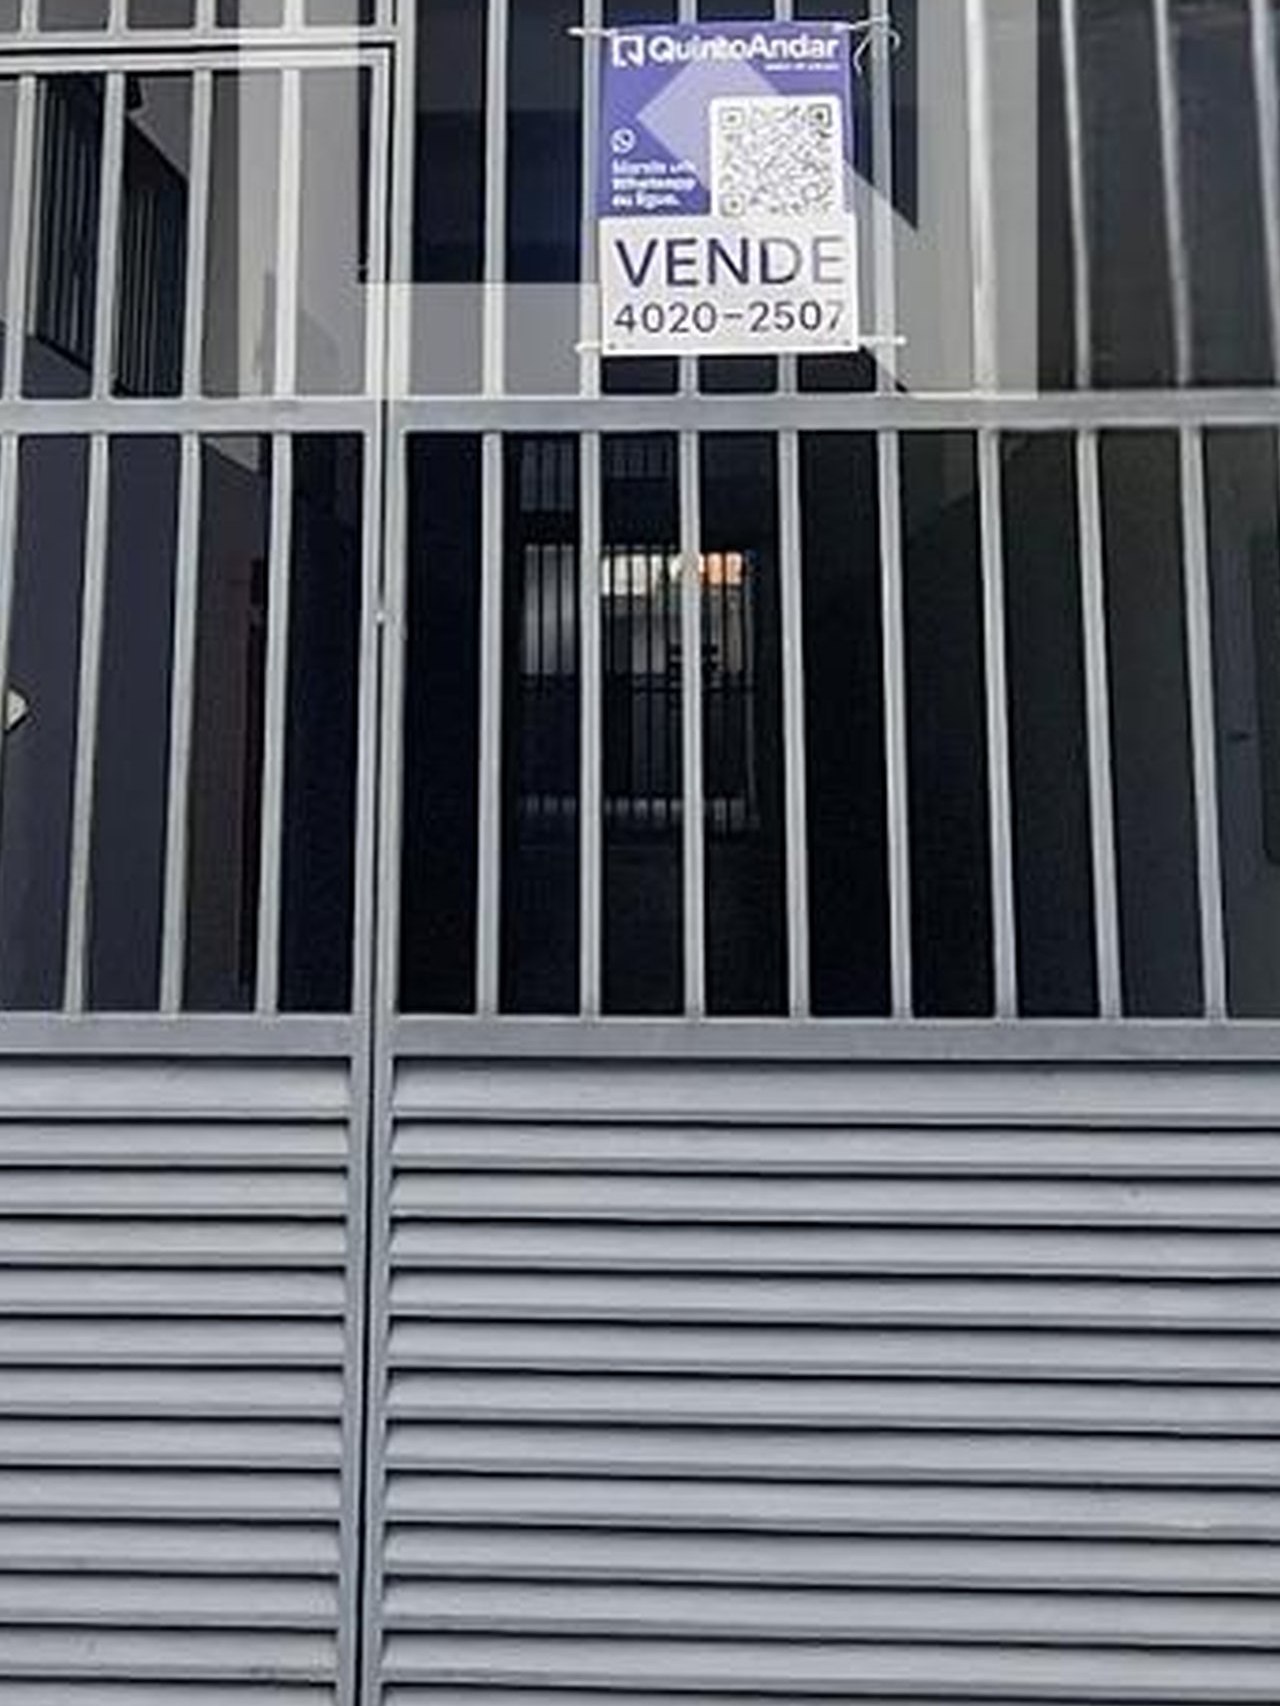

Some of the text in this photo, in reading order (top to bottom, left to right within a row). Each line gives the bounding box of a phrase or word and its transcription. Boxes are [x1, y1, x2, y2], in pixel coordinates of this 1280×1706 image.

[648, 34, 840, 63] QuintoAndar
[614, 235, 846, 288] VENDE
[613, 299, 846, 334] 4020-2507
